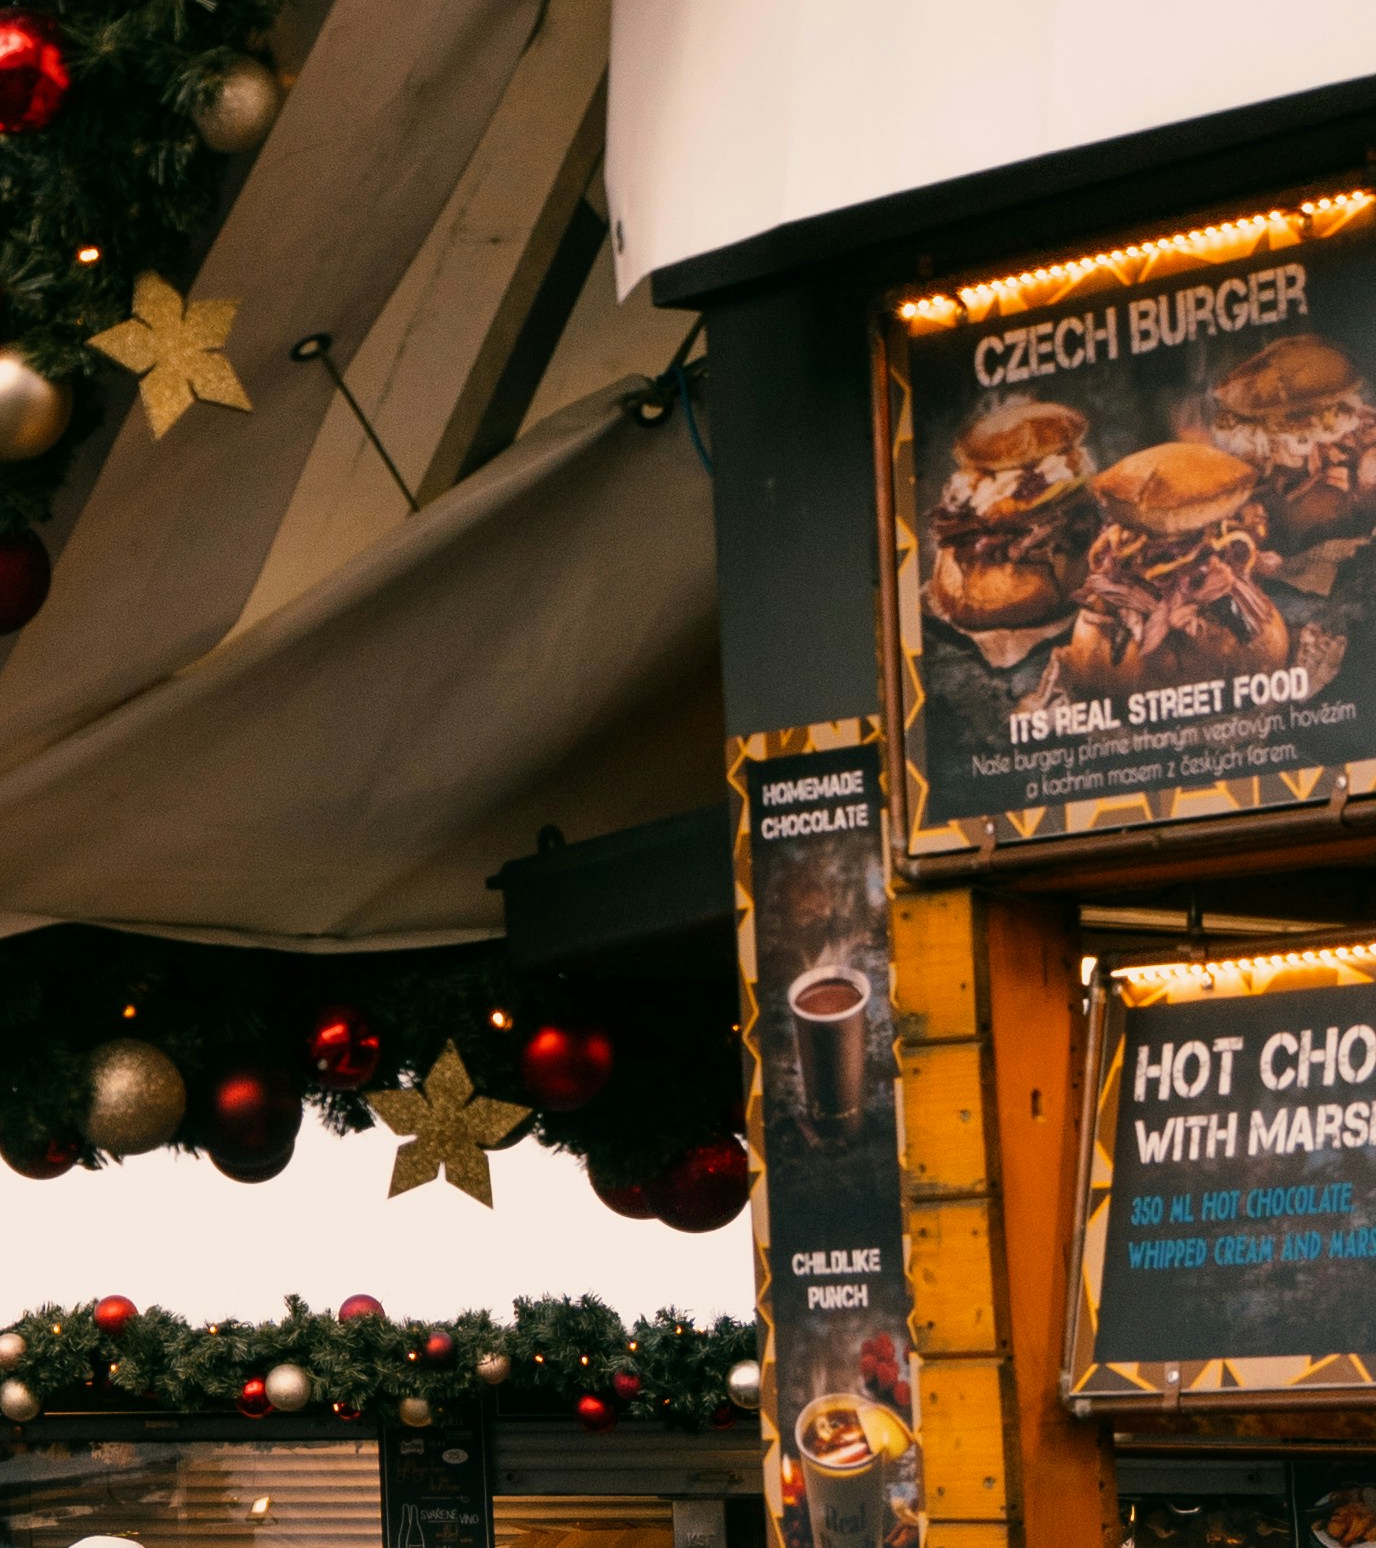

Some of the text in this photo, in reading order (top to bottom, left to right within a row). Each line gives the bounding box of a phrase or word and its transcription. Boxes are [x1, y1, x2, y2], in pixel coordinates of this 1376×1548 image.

[974, 263, 1309, 387] CZECH BURGER
[1009, 666, 1309, 744] ITS REAL STREET FOOD
[972, 755, 1010, 777] Naše
[1014, 746, 1074, 773] burgery
[1132, 725, 1198, 752] trhaným
[1290, 701, 1356, 729] hovězím
[1108, 762, 1162, 785] masem
[1166, 761, 1175, 778] z
[1180, 746, 1242, 777] českých
[762, 769, 864, 806] HOMEMADE
[761, 803, 869, 840] CHOCOLATE
[1134, 1036, 1244, 1103] HOT
[1134, 1112, 1238, 1165] WITH
[1131, 1195, 1165, 1225] 350
[1170, 1192, 1195, 1223] ML
[1201, 1190, 1241, 1221] HOT
[791, 1248, 881, 1276] CHILDLIKE
[1128, 1237, 1208, 1270] WHIPPED
[1213, 1233, 1275, 1266] CREAM
[1280, 1231, 1322, 1262] AND
[808, 1283, 869, 1310] PUNCH
